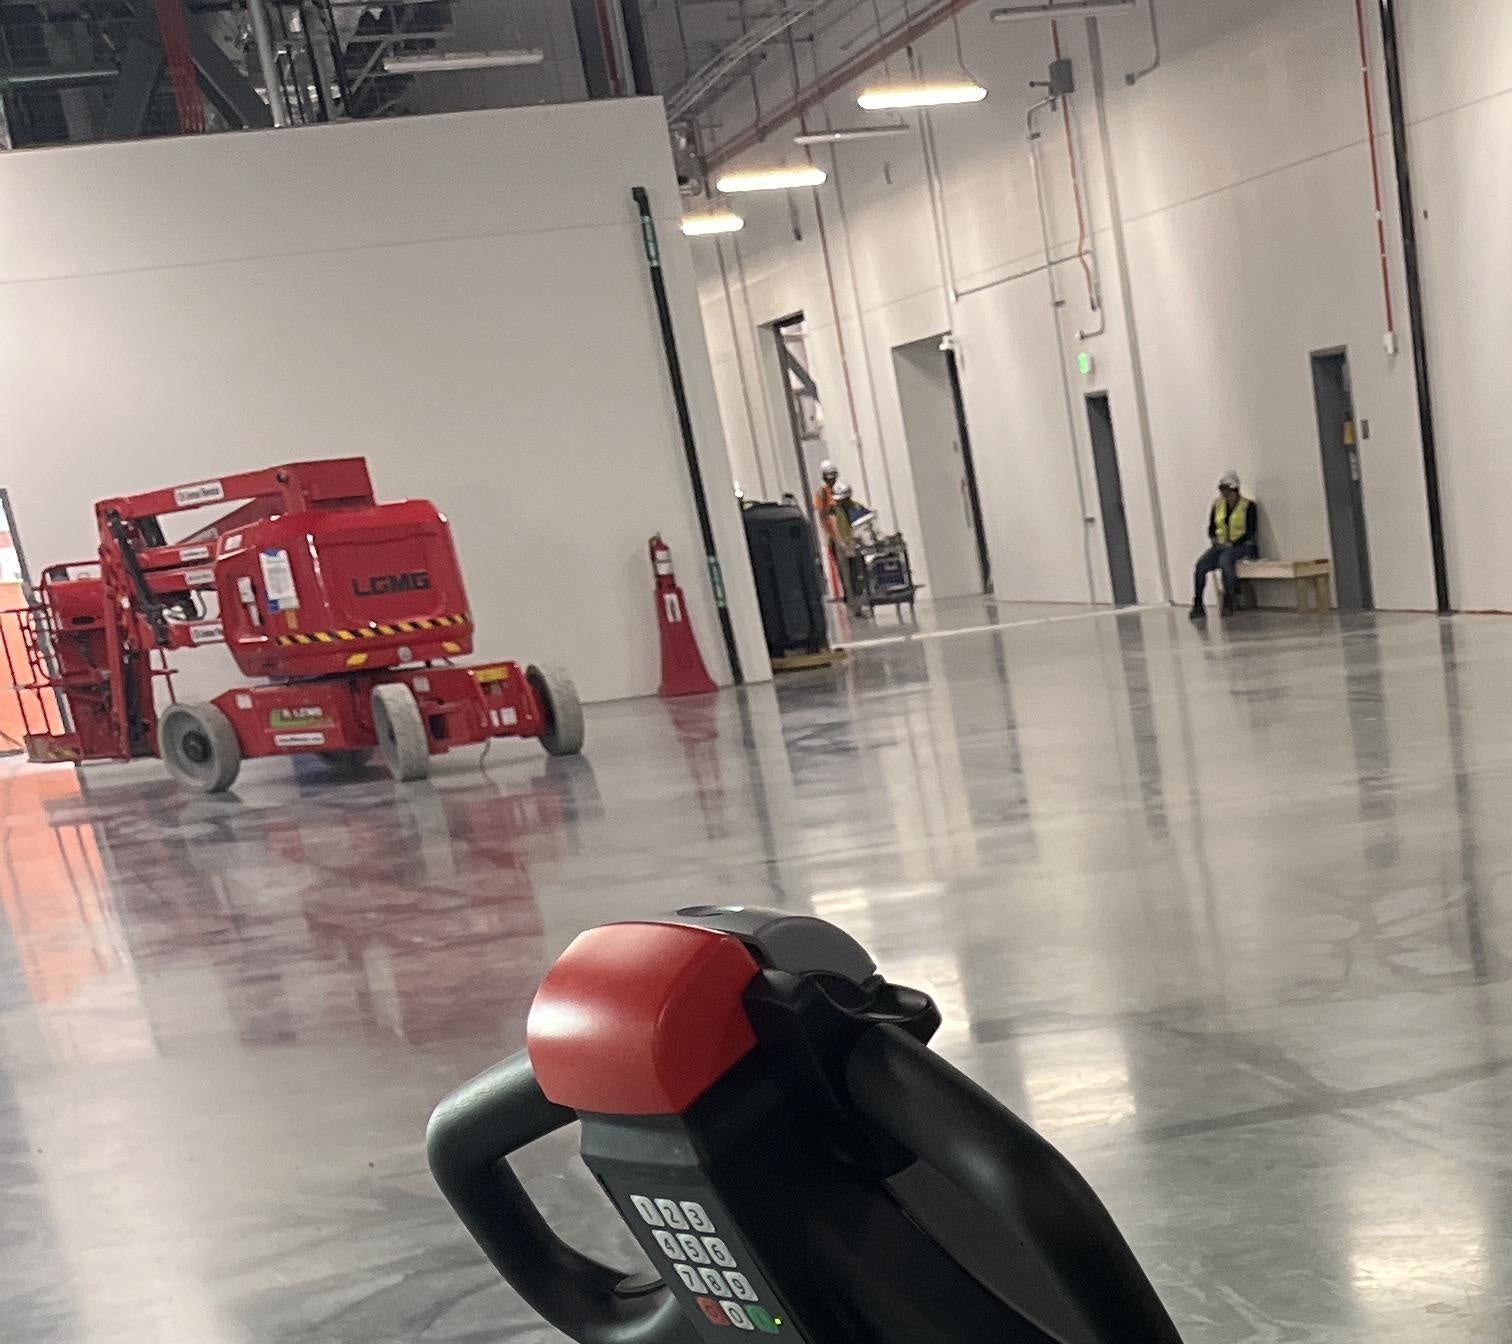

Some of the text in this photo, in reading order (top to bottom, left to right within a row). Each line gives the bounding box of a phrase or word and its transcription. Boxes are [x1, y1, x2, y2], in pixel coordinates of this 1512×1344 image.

[640, 1202, 704, 1226] 1 2 3
[663, 1238, 726, 1262] 4 5 6
[682, 1270, 746, 1295] 7 8 9
[728, 1307, 744, 1324] 0
